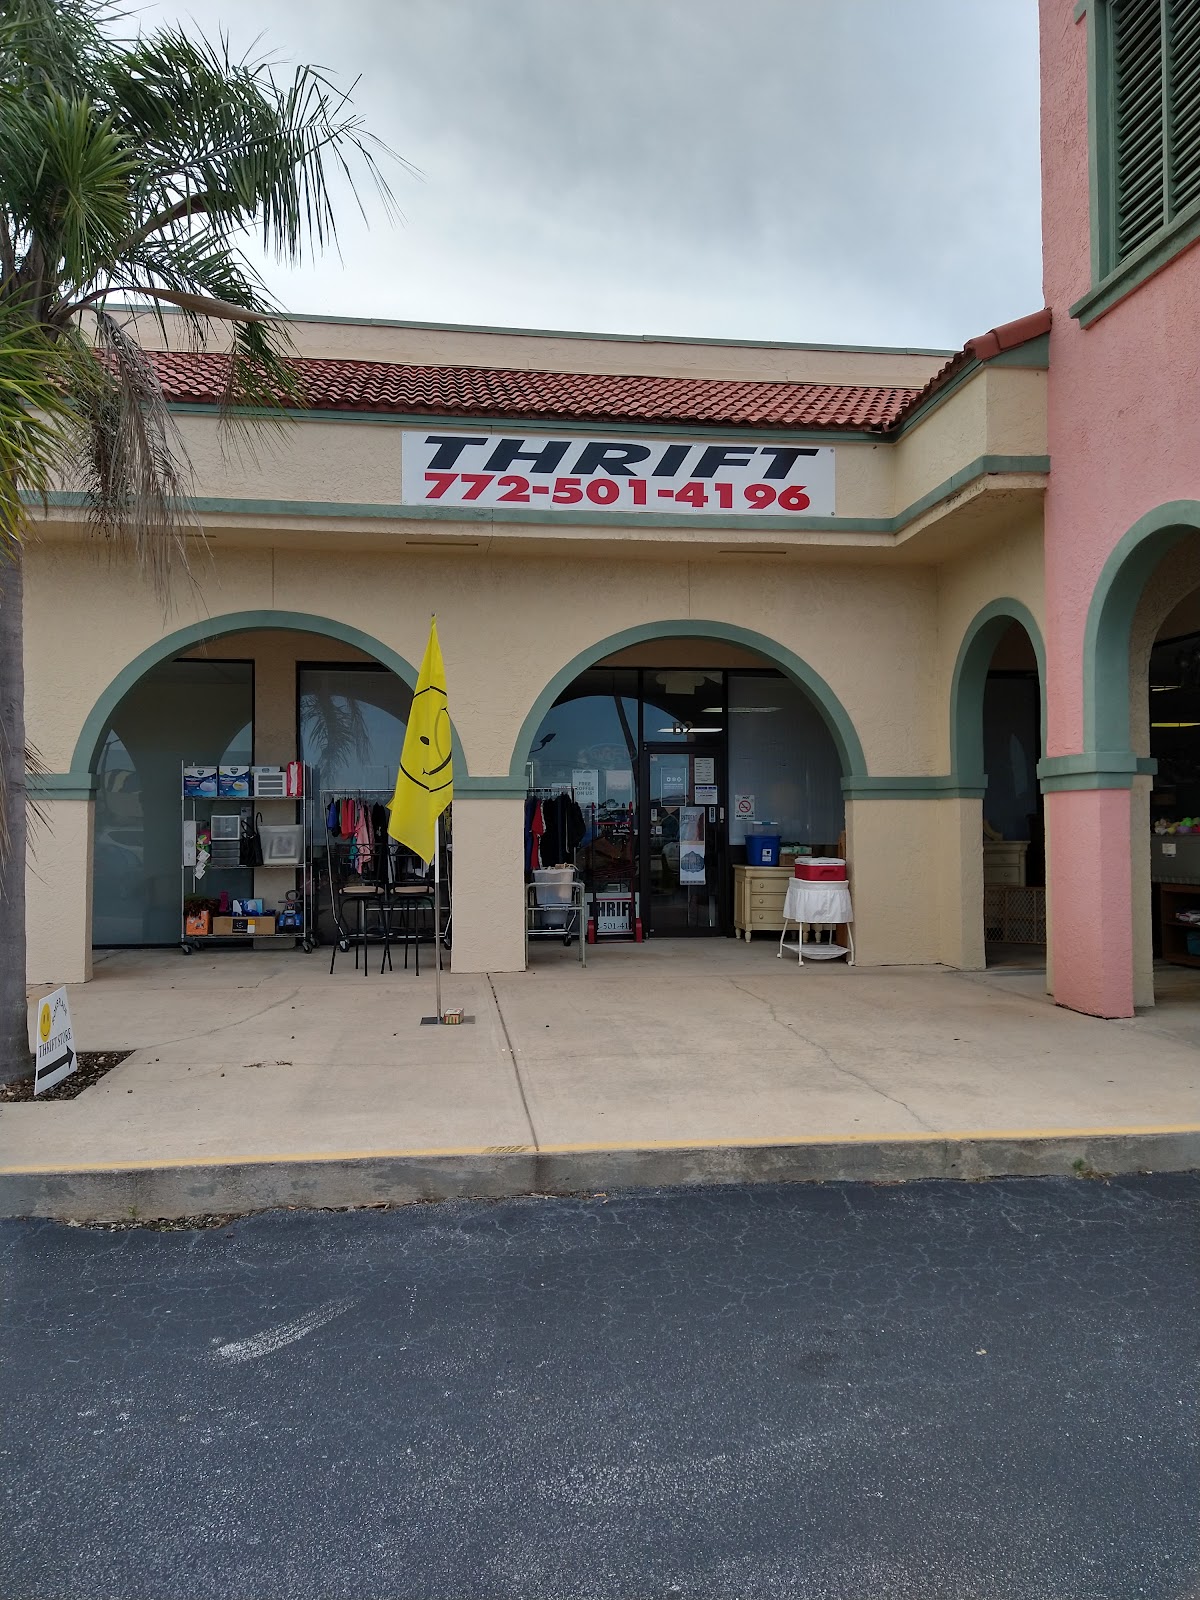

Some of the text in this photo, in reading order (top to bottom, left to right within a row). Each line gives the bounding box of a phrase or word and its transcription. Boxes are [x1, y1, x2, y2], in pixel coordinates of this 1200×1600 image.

[424, 435, 819, 479] THRIFT
[424, 472, 811, 511] 772-501-4196
[38, 1027, 72, 1058] THRIFT STORE
